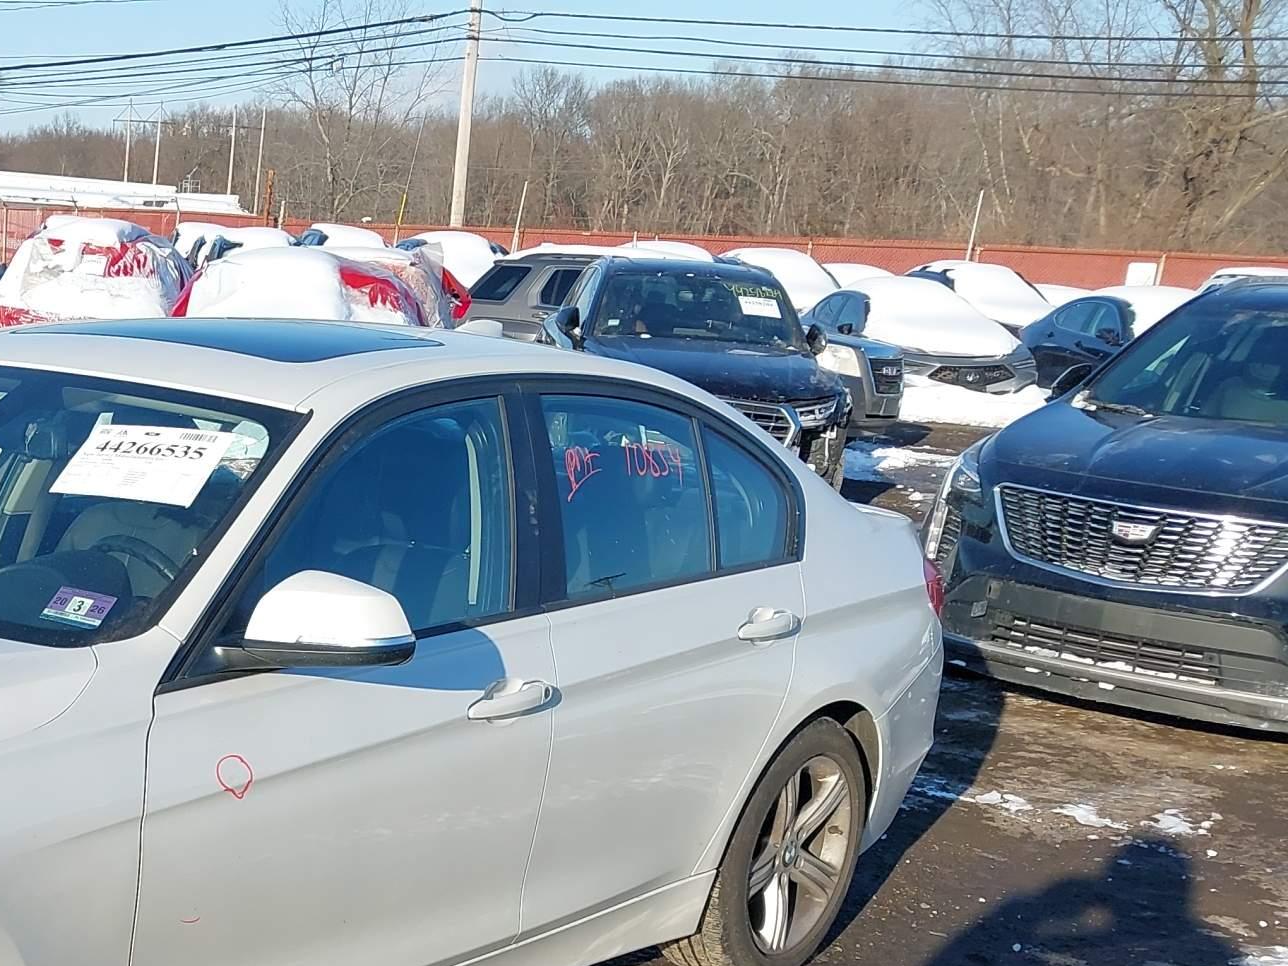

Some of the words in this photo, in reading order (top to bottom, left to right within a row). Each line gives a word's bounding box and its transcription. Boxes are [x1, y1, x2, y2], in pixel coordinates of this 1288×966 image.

[95, 439, 208, 460] 44266535
[53, 596, 68, 606] 20
[73, 600, 85, 612] 3
[89, 605, 106, 615] 26
